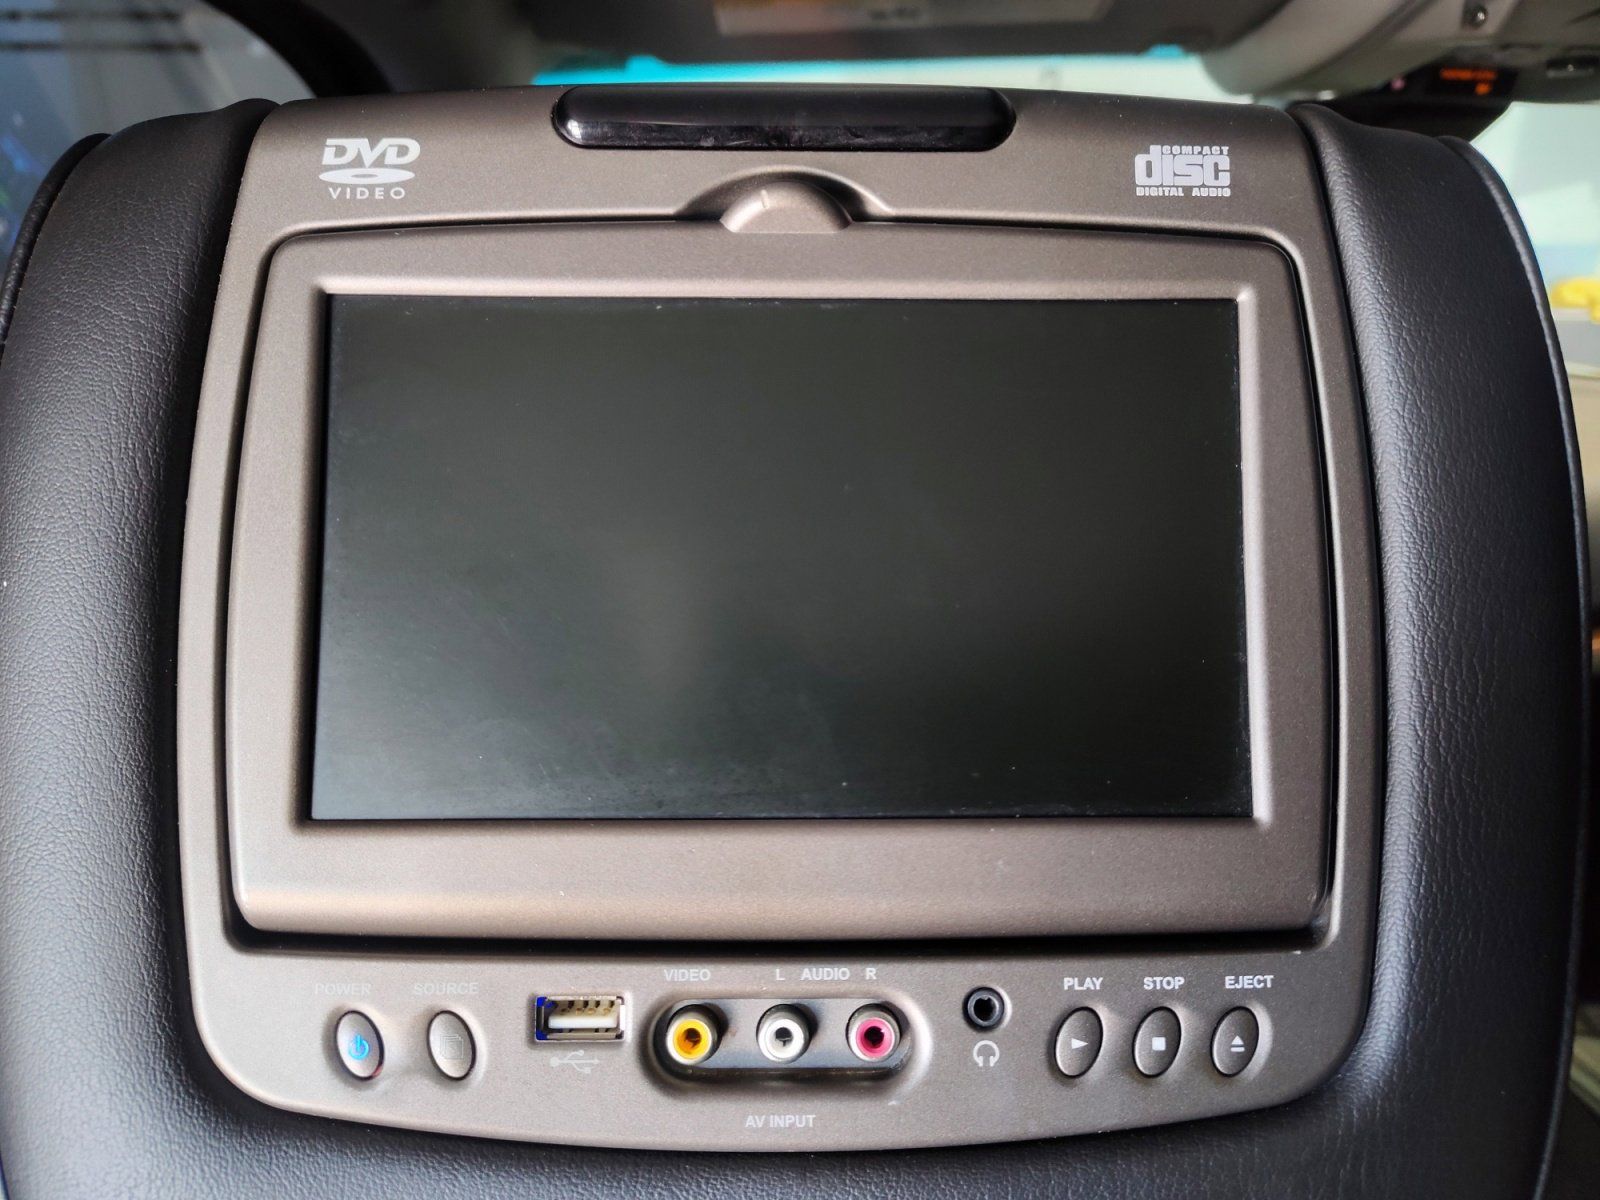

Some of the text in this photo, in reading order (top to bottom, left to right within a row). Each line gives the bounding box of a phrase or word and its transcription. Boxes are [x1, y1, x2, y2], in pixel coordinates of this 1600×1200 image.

[322, 137, 421, 168] DVD
[1162, 145, 1229, 155] COMPACT
[328, 187, 406, 199] VIDEO
[1136, 187, 1231, 197] DIGITAL AUDIO
[664, 969, 711, 981] VIDEO
[776, 968, 877, 980] L AUDIO R
[1063, 977, 1103, 990] PLAY
[1143, 977, 1185, 990] STOP
[1225, 975, 1274, 989] EJECT
[314, 983, 372, 995] POWER
[413, 982, 479, 995] SOURCE
[745, 1115, 816, 1128] AV INPUT
